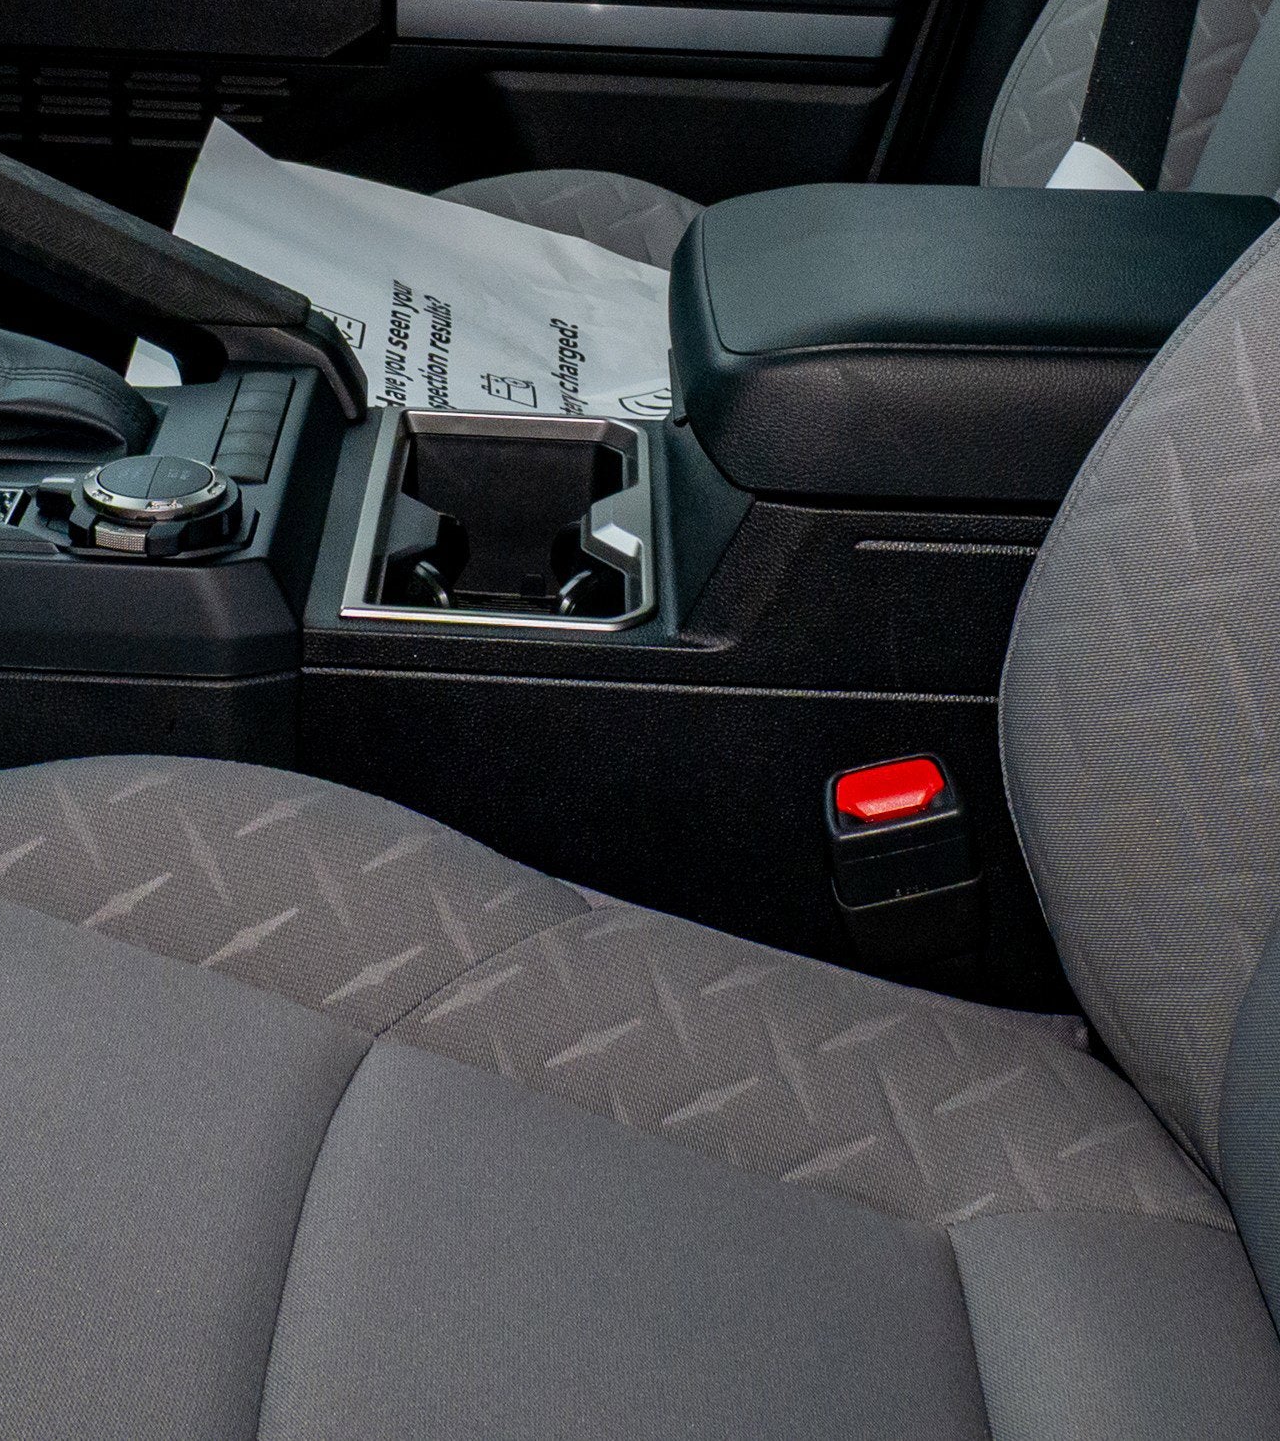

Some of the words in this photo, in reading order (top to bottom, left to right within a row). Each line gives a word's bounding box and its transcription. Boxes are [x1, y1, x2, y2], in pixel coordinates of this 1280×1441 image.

[393, 280, 420, 313] your
[390, 311, 412, 351] seen
[423, 295, 452, 354] results?
[385, 350, 414, 381] you
[417, 350, 456, 409] spection
[551, 318, 586, 394] charged?
